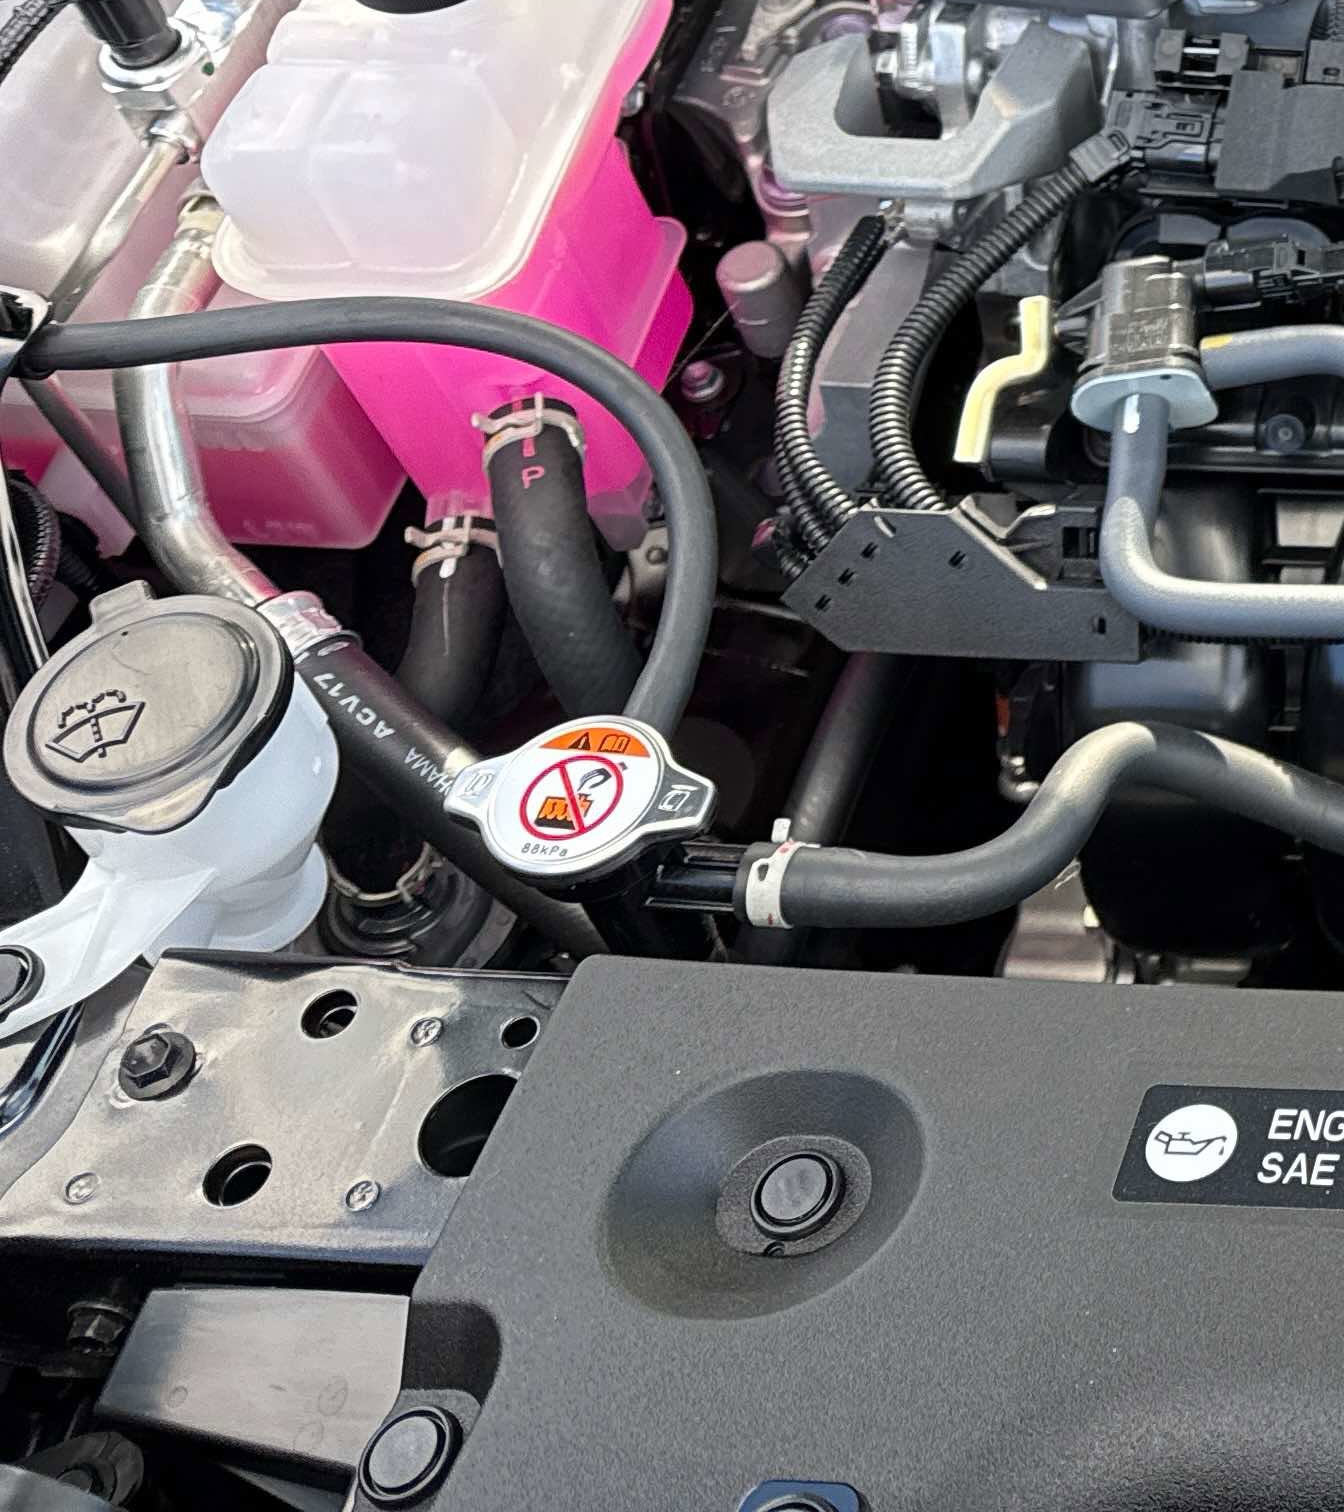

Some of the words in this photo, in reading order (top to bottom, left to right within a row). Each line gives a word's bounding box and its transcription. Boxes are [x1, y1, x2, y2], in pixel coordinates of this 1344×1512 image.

[521, 465, 545, 489] P
[312, 672, 396, 740] ACV17
[520, 841, 569, 858] 88kPa
[1256, 1151, 1341, 1187] SAE
